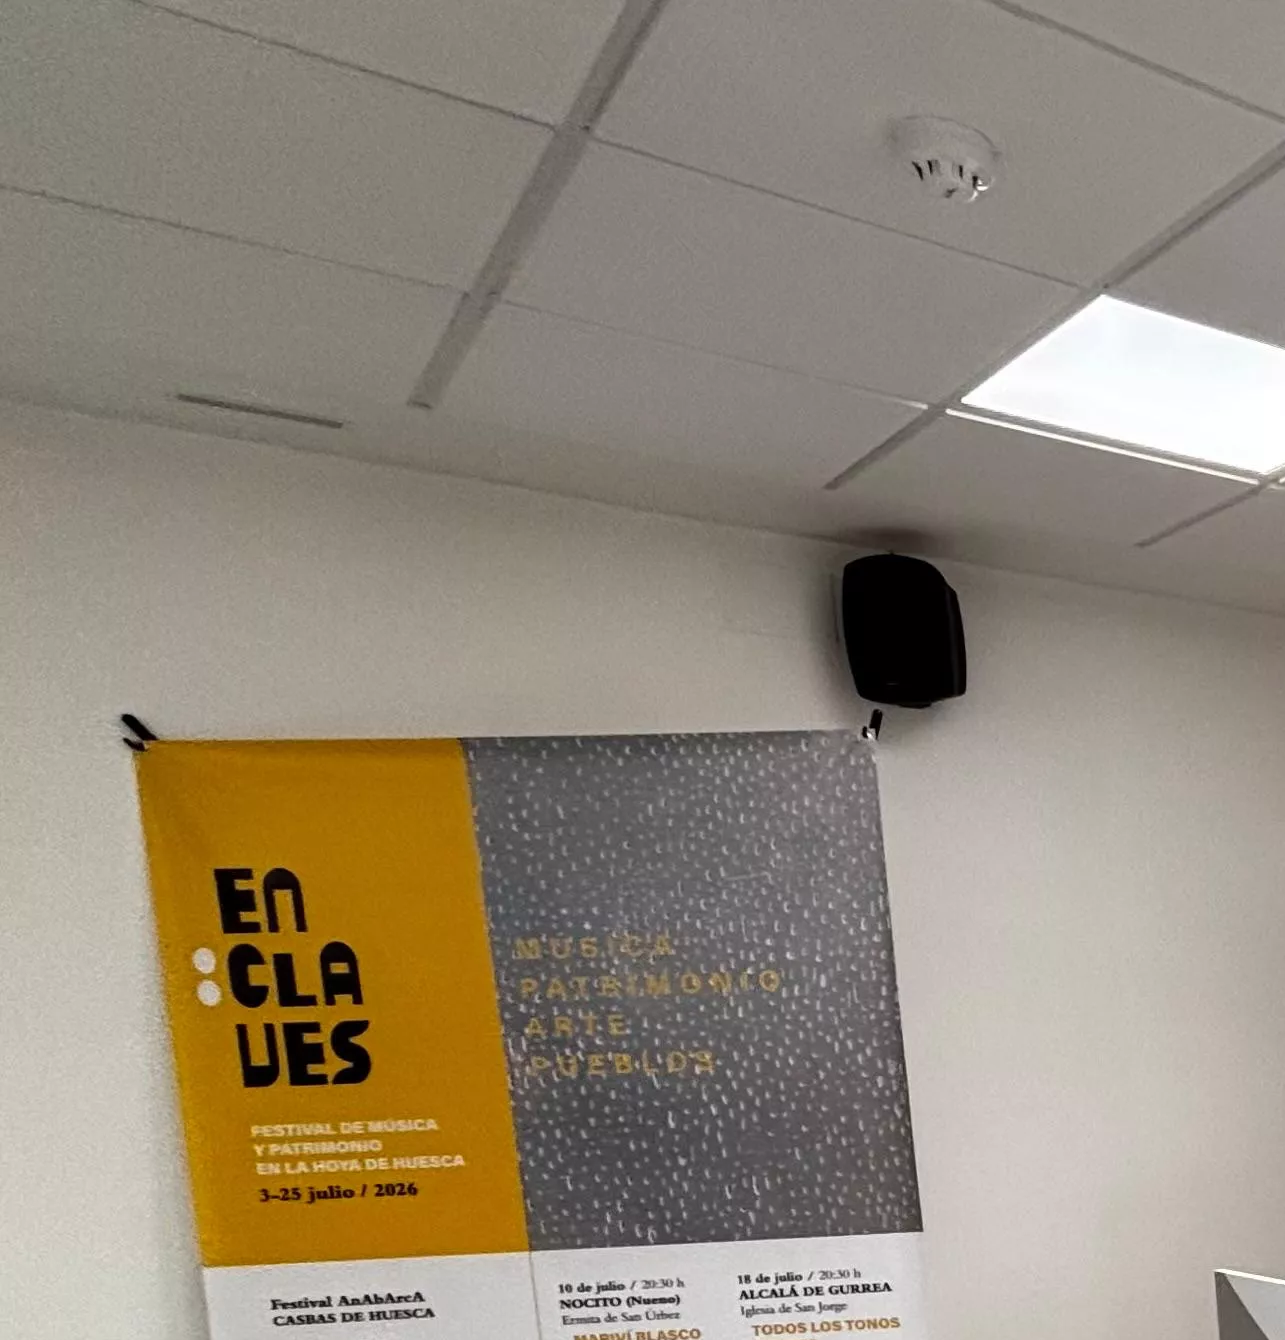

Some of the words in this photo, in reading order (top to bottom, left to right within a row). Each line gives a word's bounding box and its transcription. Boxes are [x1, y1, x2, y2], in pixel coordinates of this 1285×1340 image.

[524, 1014, 630, 1037] ARTE
[256, 1163, 281, 1175] EN
[284, 1161, 311, 1174] LA
[312, 1159, 362, 1172] HOYA
[365, 1158, 391, 1170] DE
[392, 1155, 465, 1169] HUESCA
[307, 1185, 355, 1203] julio
[374, 1182, 418, 1197] 2026
[738, 1275, 751, 1284] 18
[756, 1274, 770, 1283] de
[774, 1272, 803, 1285] julio
[559, 1284, 573, 1294] 10
[577, 1283, 592, 1292] de
[596, 1281, 625, 1294] julio
[740, 1285, 799, 1300] ALCALÁ
[803, 1286, 824, 1296] DE
[828, 1283, 892, 1295] GURREA
[271, 1296, 333, 1310] Festival
[560, 1297, 621, 1309] NOCITO
[273, 1313, 337, 1326] CASBAS
[341, 1312, 365, 1323] DE
[368, 1308, 435, 1321] HUESCA
[752, 1322, 807, 1336] TODOS
[811, 1320, 842, 1333] LOS
[844, 1317, 900, 1331] TONOS
